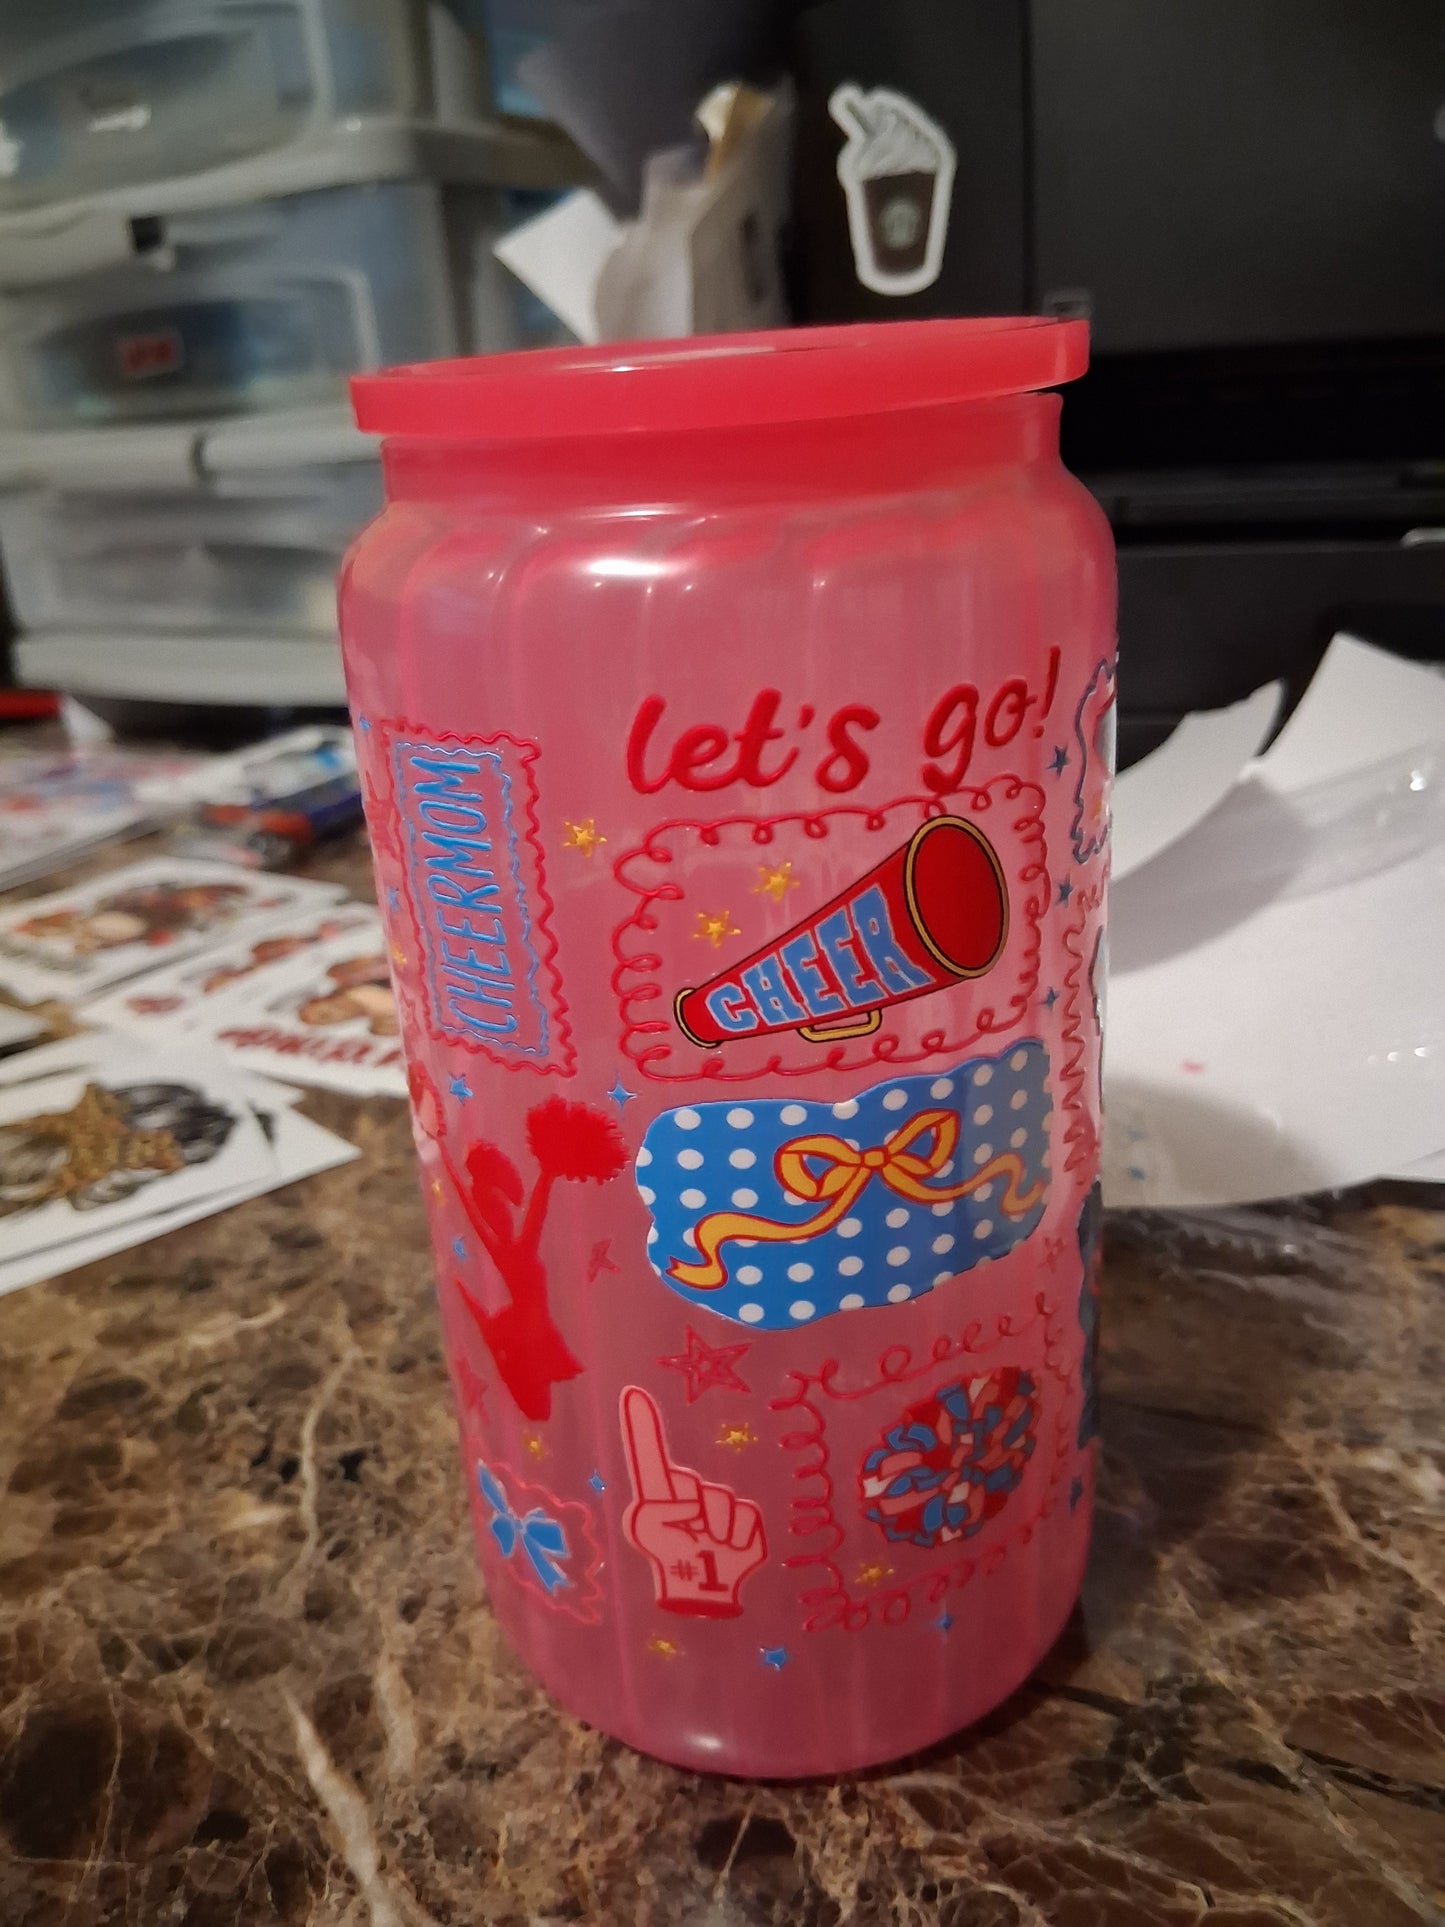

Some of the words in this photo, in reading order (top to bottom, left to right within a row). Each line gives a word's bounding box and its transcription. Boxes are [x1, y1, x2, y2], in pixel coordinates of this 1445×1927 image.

[922, 645, 1060, 793] go!
[705, 883, 936, 1032] CHEER
[670, 1549, 729, 1592] #1
